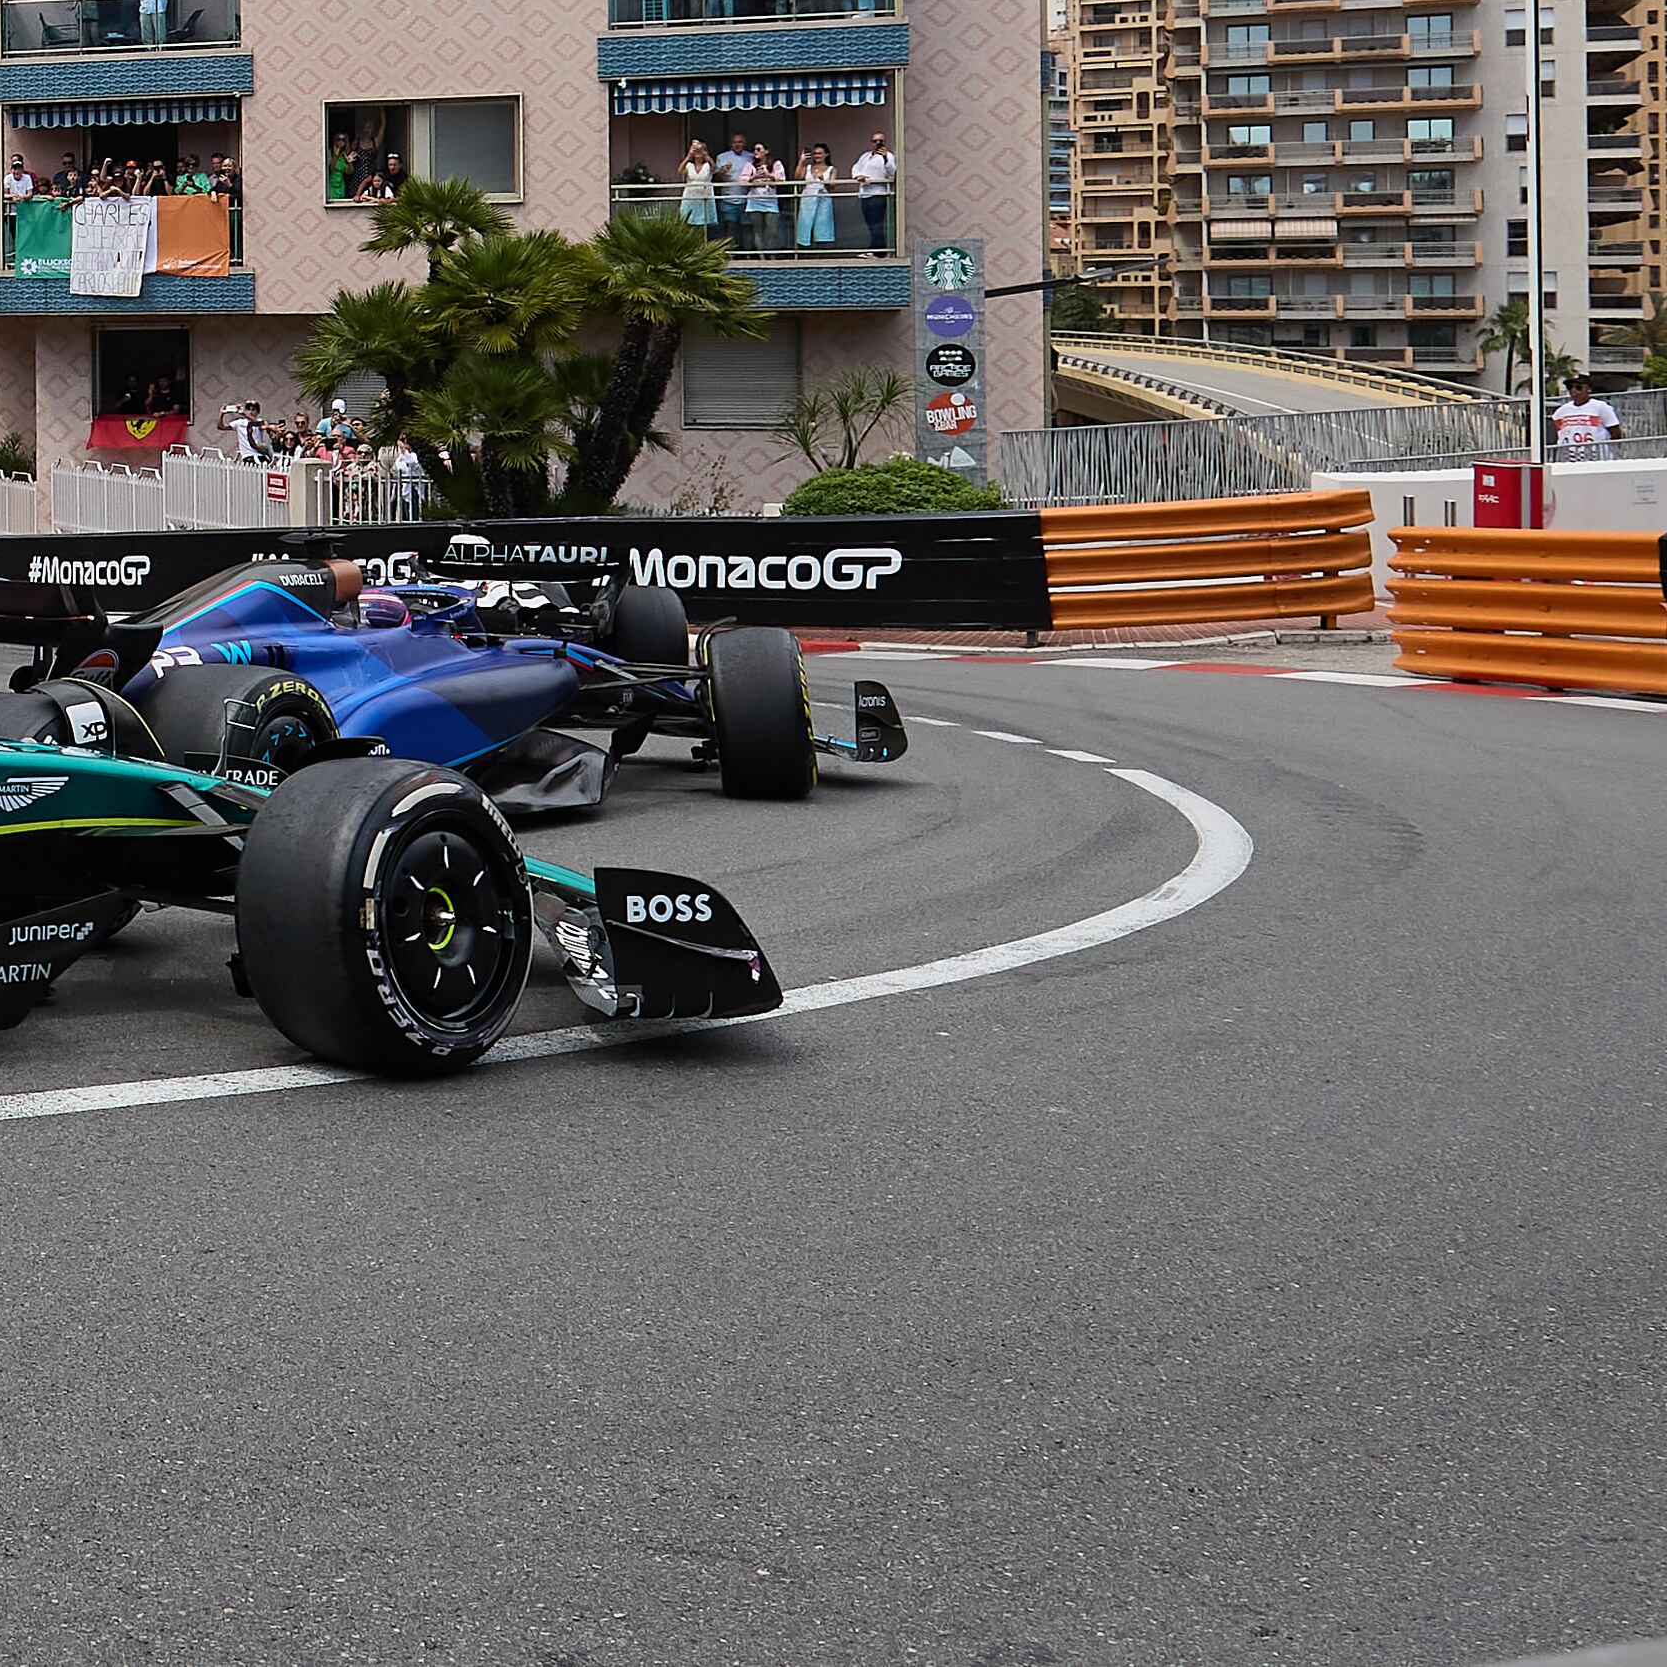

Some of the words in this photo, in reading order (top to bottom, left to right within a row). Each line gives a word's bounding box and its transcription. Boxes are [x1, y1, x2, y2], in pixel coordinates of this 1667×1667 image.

[74, 203, 149, 227] CHARLES
[926, 404, 977, 425] BOWLING
[934, 418, 957, 432] &BAR
[28, 554, 150, 588] #MonacoGP
[592, 547, 903, 590] MonacoGP
[278, 573, 325, 586] DURACELL
[269, 680, 319, 700] ZERO
[858, 694, 887, 708] Acronis
[626, 893, 713, 924] BOSS
